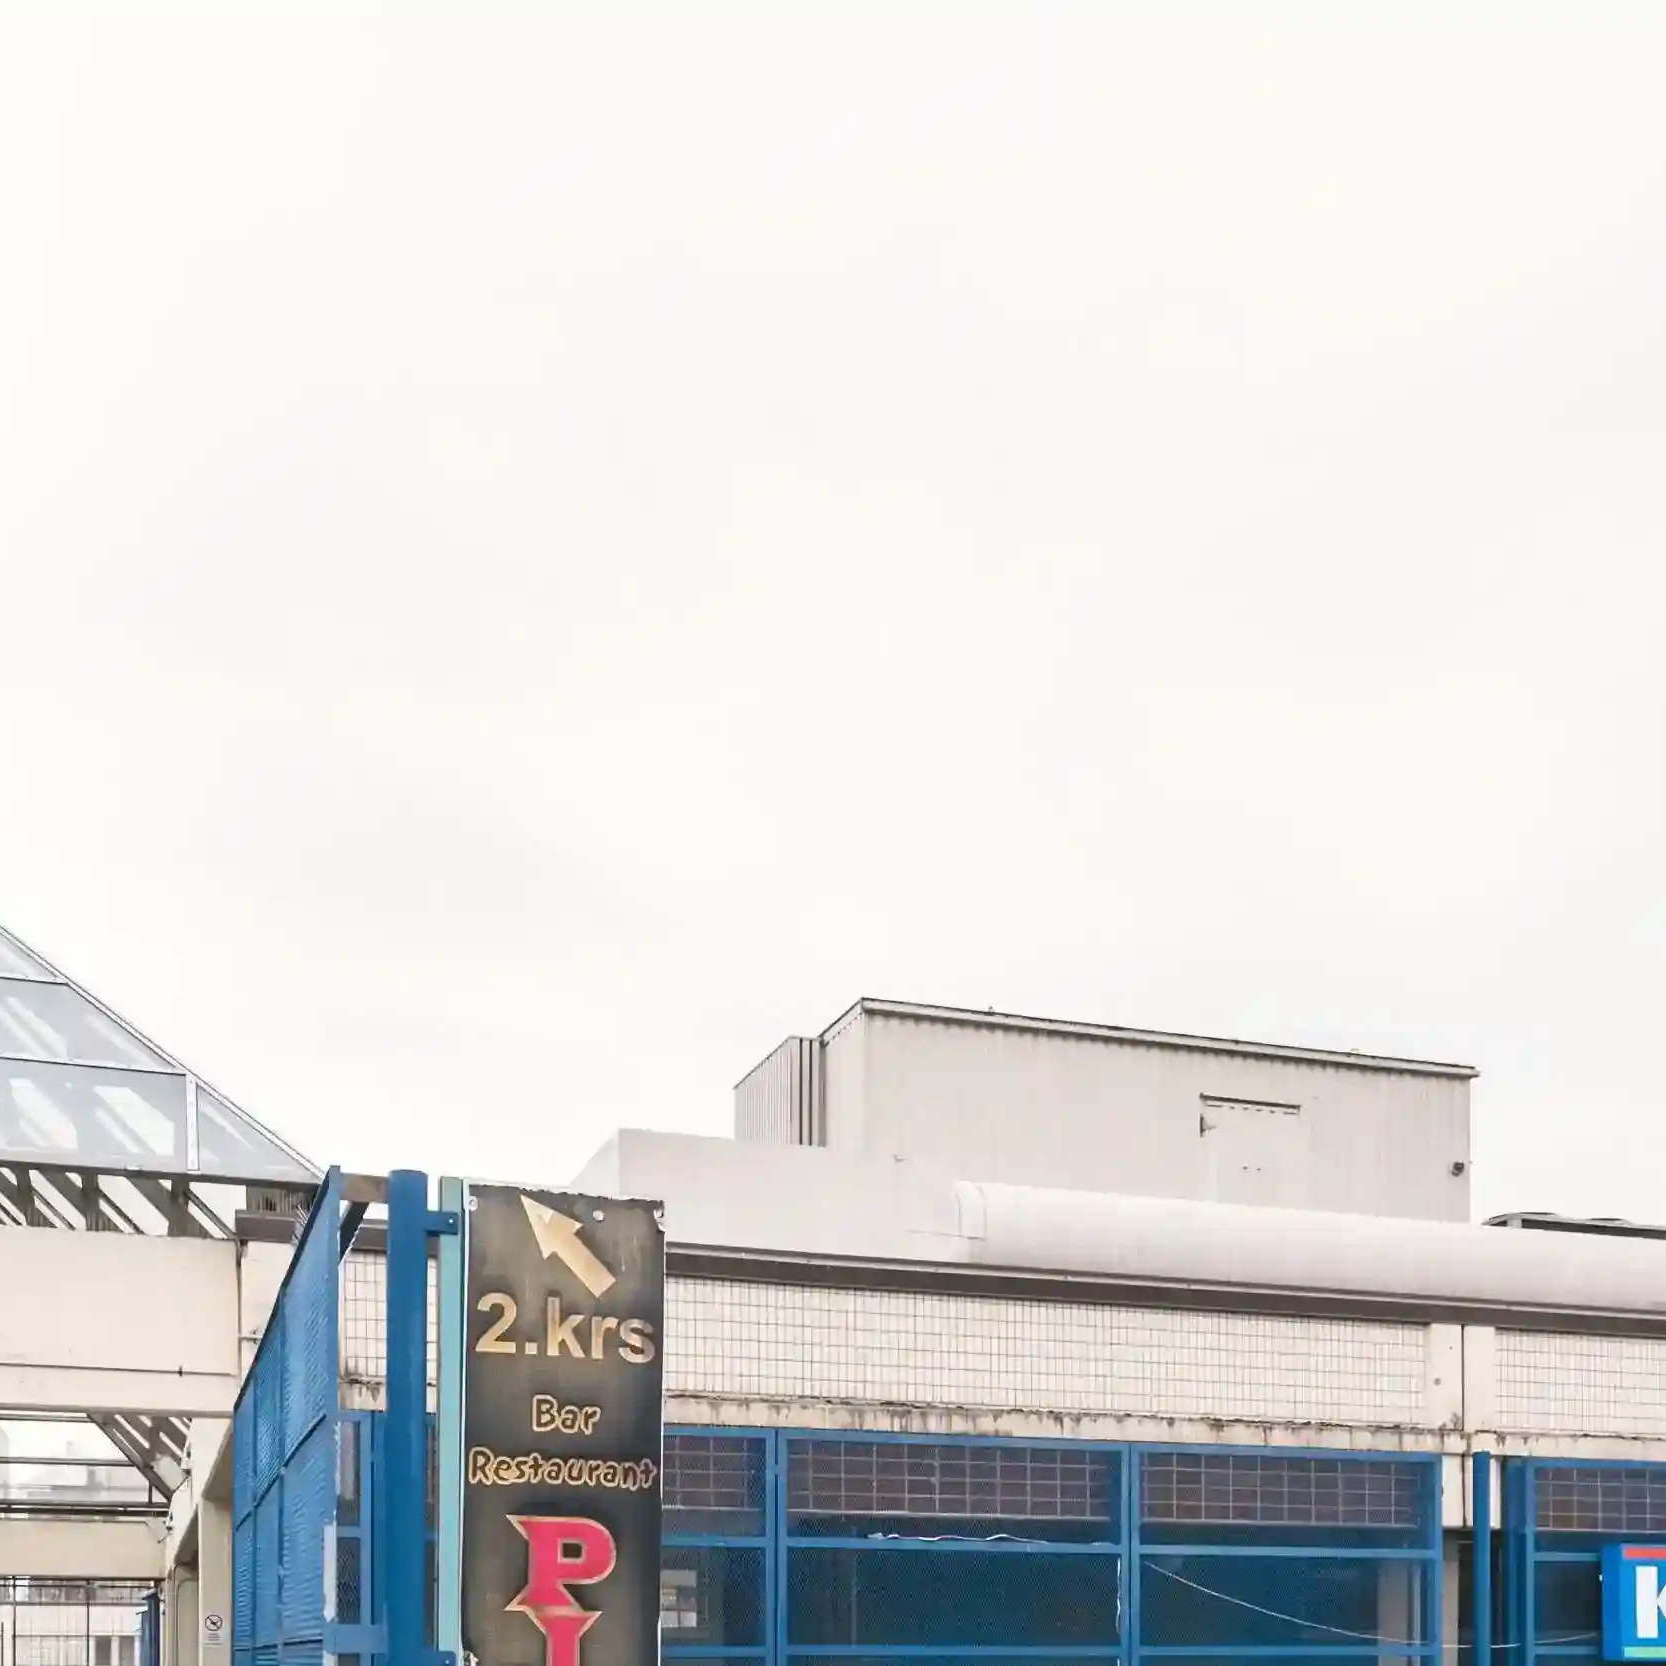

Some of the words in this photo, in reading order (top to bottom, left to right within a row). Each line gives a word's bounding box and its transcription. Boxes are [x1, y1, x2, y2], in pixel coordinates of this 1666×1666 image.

[474, 1292, 657, 1365] 2.krs
[531, 1394, 602, 1435] Bar
[468, 1446, 659, 1492] Restaurant
